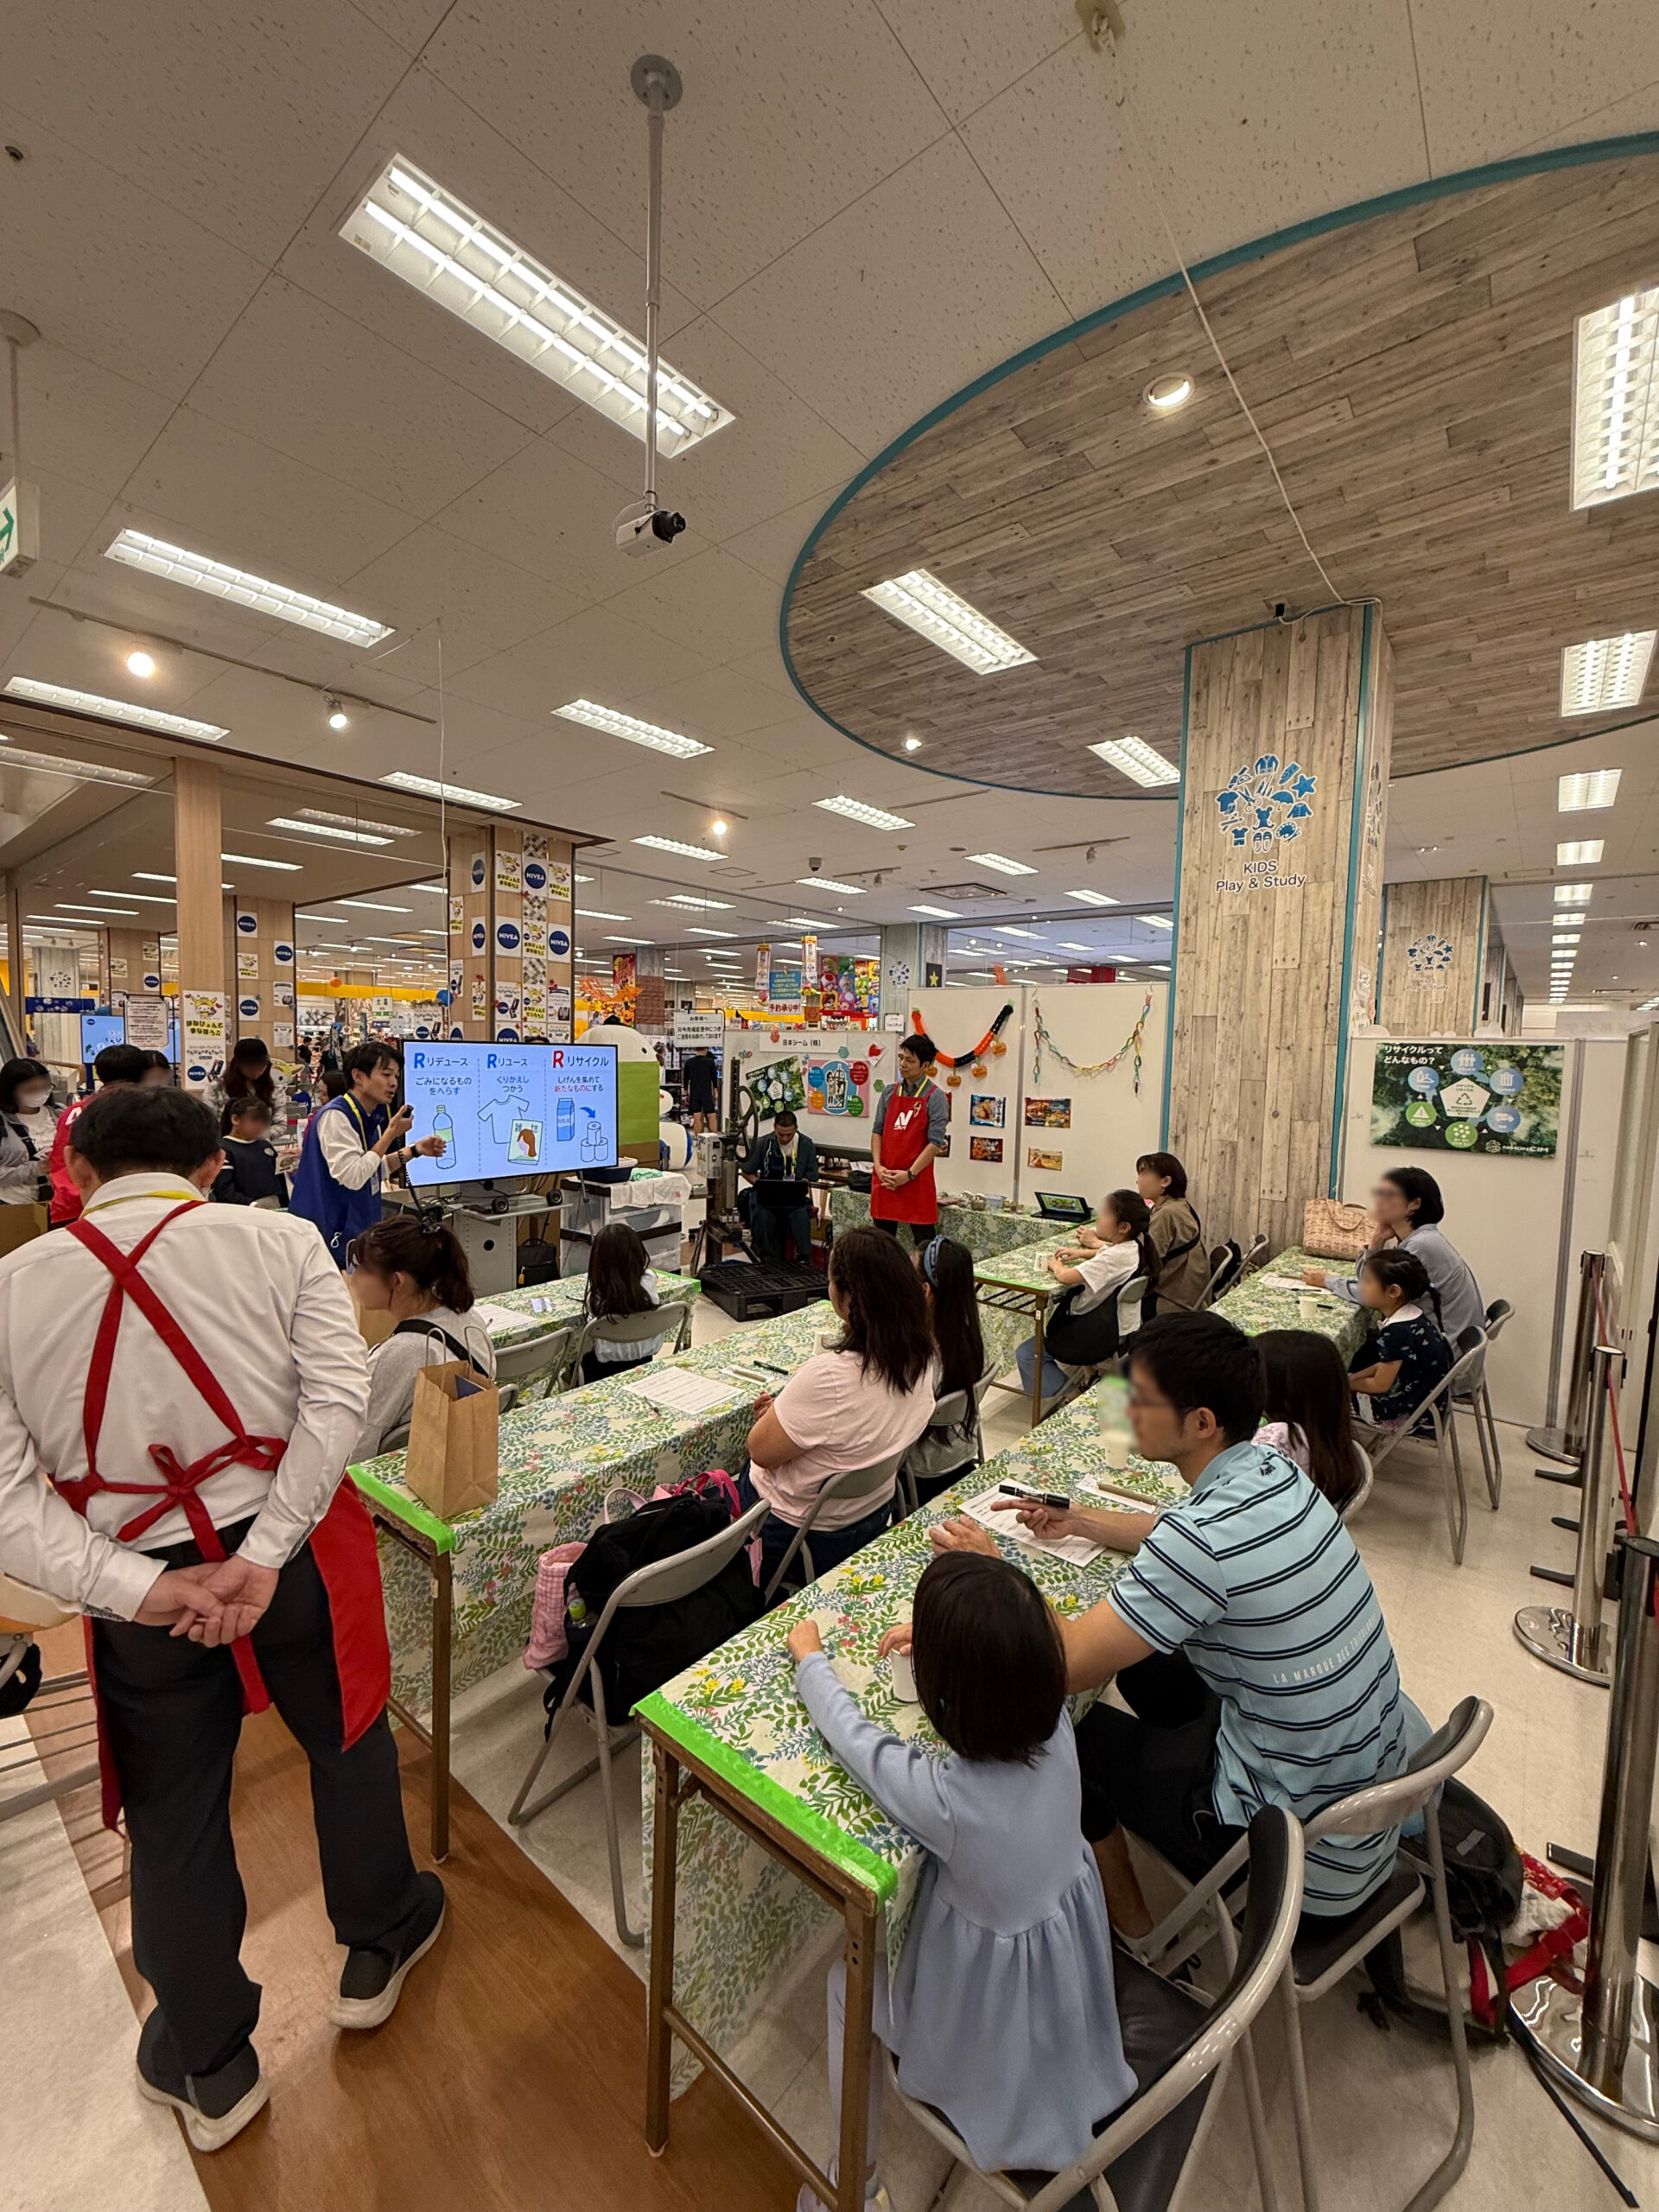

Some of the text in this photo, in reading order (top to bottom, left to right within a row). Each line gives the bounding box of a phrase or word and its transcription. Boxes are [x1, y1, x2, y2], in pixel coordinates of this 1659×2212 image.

[1243, 861, 1277, 874] KIDS
[1216, 874, 1306, 892] Play & Study
[1384, 1046, 1443, 1054] リサイクルって
[427, 1058, 468, 1066] リデュース
[499, 1058, 528, 1066] リユース
[567, 1056, 608, 1066] リサイクル
[416, 1077, 472, 1085] ごみになるもの
[429, 1087, 460, 1096] をへらす
[1273, 1673, 1287, 1683] LA
[1294, 1658, 1334, 1681] MARQUE
[1336, 1646, 1350, 1663] DES
